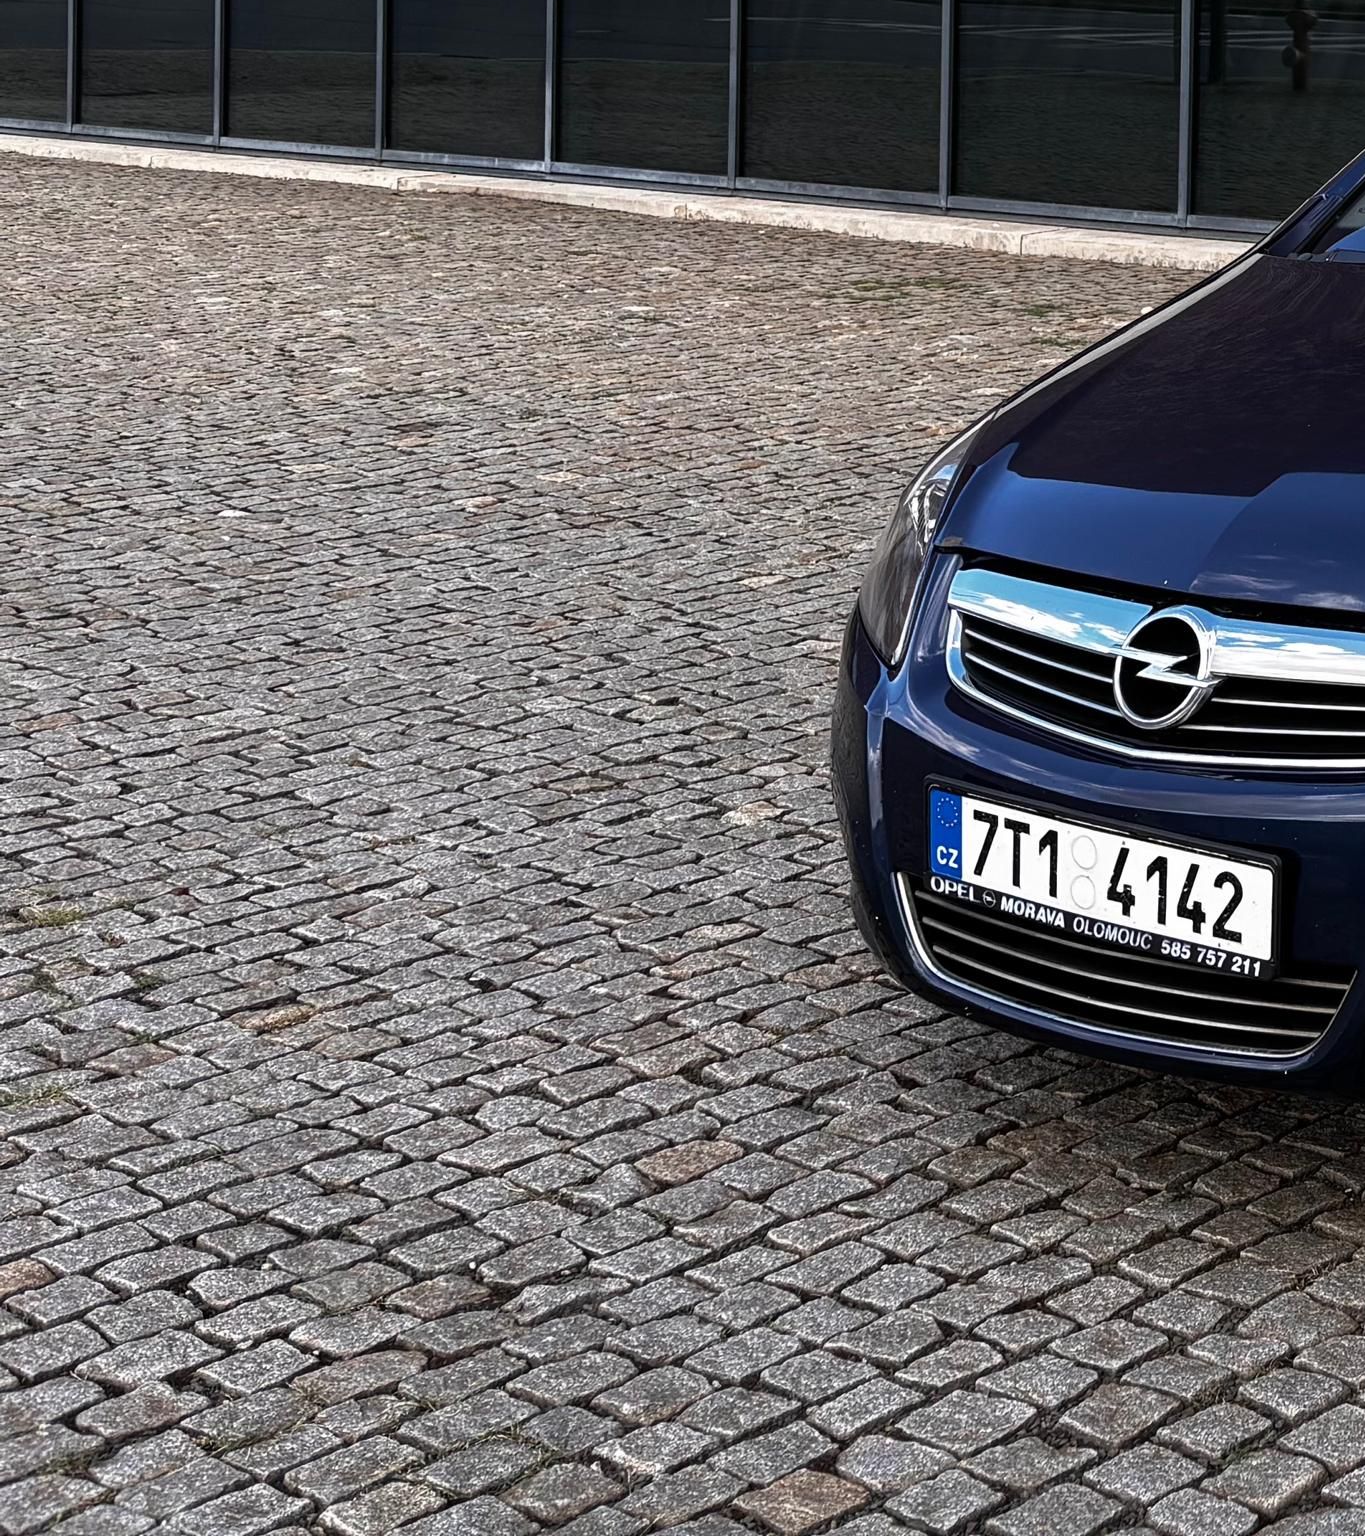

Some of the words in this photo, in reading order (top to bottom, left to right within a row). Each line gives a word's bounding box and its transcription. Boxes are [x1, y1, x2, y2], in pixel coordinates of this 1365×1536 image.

[936, 845, 959, 869] CZ
[973, 809, 1059, 898] 7T1
[1106, 847, 1243, 944] 4142
[930, 875, 982, 904] OPEL
[1000, 896, 1065, 928] MORAVA
[1073, 916, 1153, 950] OLOMOUC
[1160, 939, 1191, 960] 585
[1196, 947, 1228, 968] 757
[1230, 955, 1261, 977] 211
